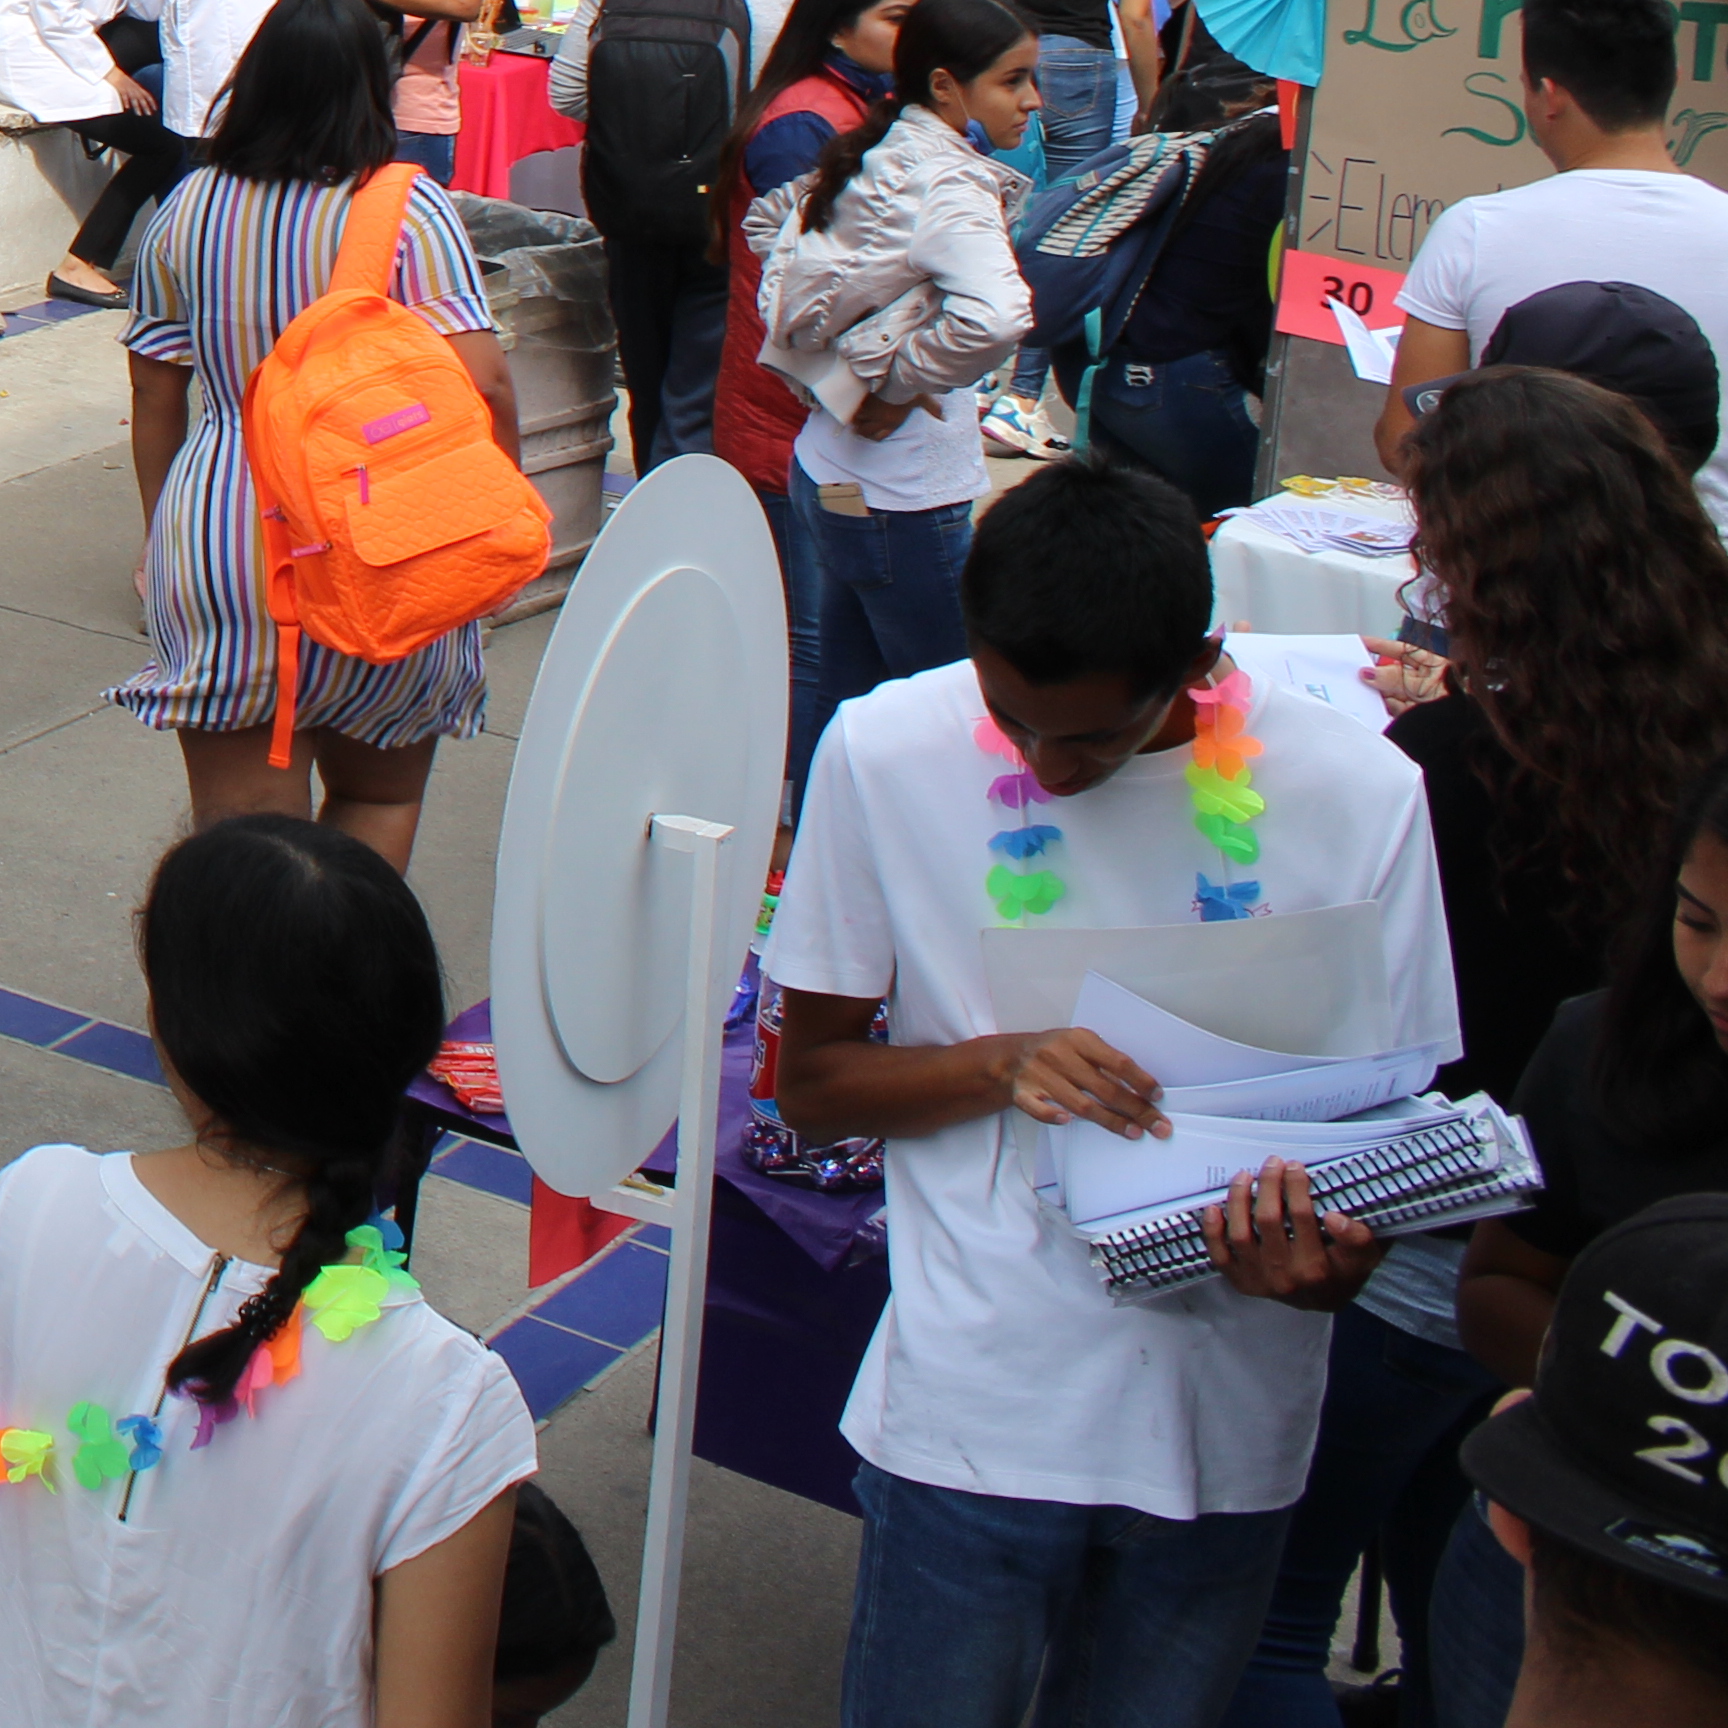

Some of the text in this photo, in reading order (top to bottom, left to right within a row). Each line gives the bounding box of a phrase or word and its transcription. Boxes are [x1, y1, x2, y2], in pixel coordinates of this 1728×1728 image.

[1335, 157, 1445, 261] Elem
[1319, 275, 1374, 318] 30
[1633, 1413, 1728, 1491] 2
